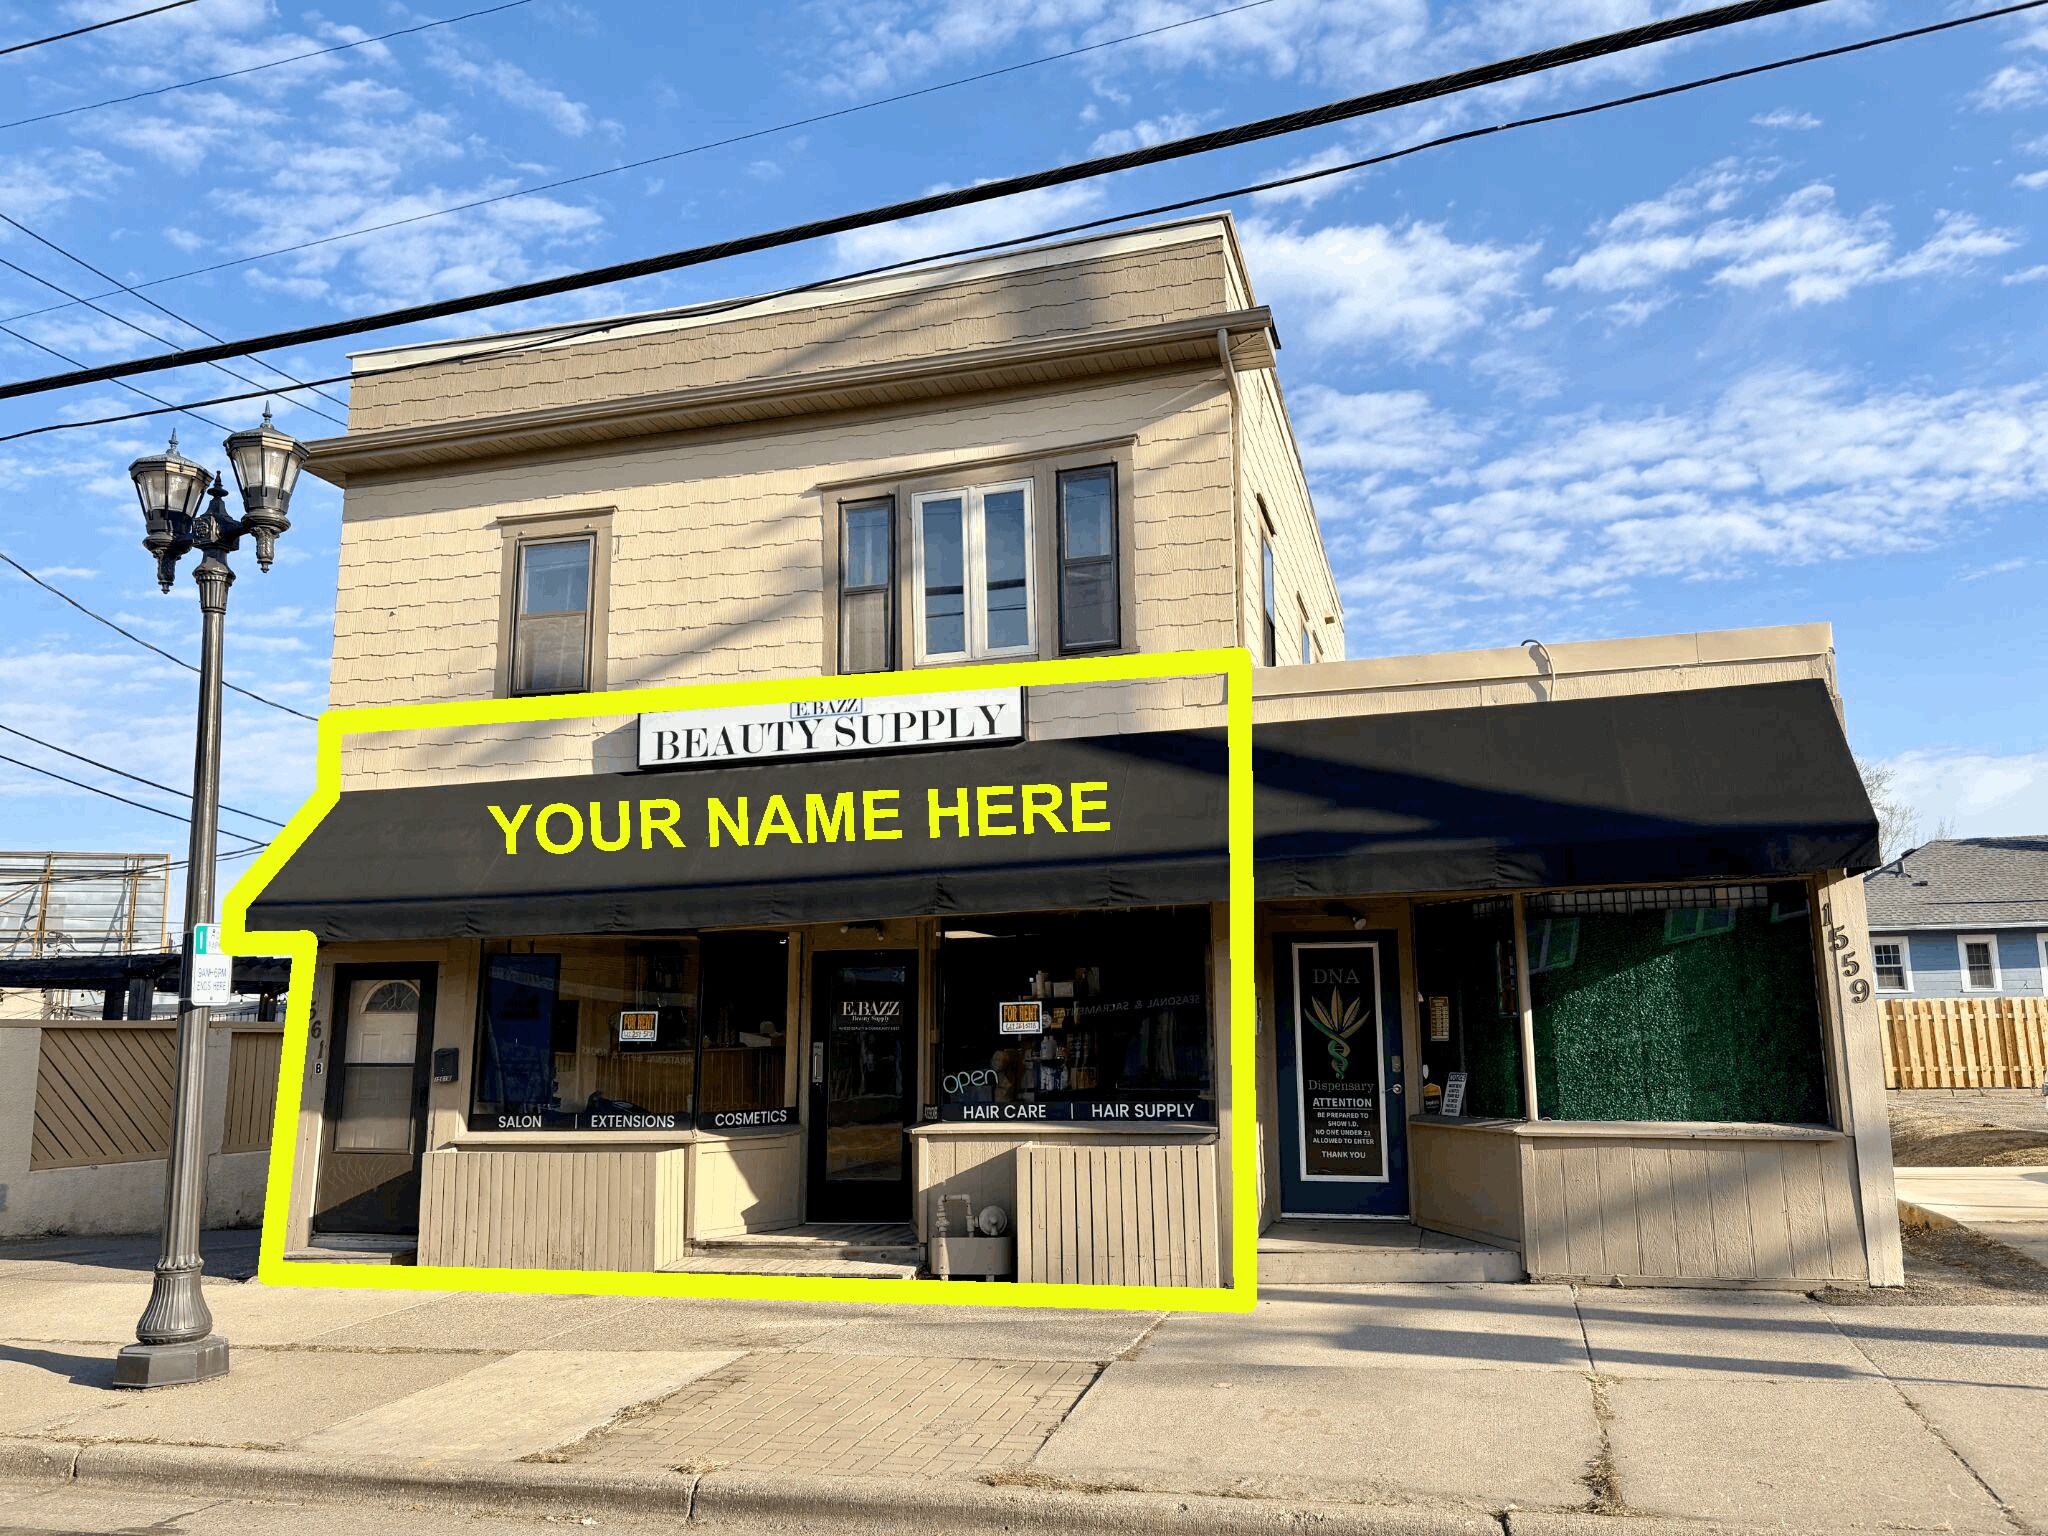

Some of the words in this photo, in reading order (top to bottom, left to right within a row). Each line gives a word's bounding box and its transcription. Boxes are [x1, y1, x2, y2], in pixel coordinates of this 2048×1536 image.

[652, 718, 824, 761] BEAUTY
[835, 703, 1007, 748] SUPPLY
[1312, 967, 1361, 985] DNA
[1003, 1005, 1018, 1022] FOR
[1020, 1004, 1039, 1022] RENT
[624, 1014, 637, 1030] FOR
[638, 1014, 655, 1030] RENT
[942, 1069, 999, 1095] open
[1308, 1080, 1375, 1094] Dispensary
[1312, 1097, 1373, 1108] ATTENTION
[714, 1109, 788, 1127] COSMETICS
[963, 1104, 1000, 1119] HAIR
[1004, 1104, 1047, 1119] CARE
[1091, 1103, 1129, 1118] HAIR
[1134, 1103, 1195, 1118] SUPPLY
[498, 1114, 542, 1129] SALON
[590, 1114, 676, 1129] EXTENSIONS
[1327, 1120, 1347, 1128] SHOW
[1340, 1129, 1363, 1137] UNDER
[1313, 1137, 1343, 1145] ALLOWED
[1353, 1138, 1375, 1146] ENTER
[1321, 1150, 1348, 1159] THANK
[1349, 1151, 1366, 1159] YOU
